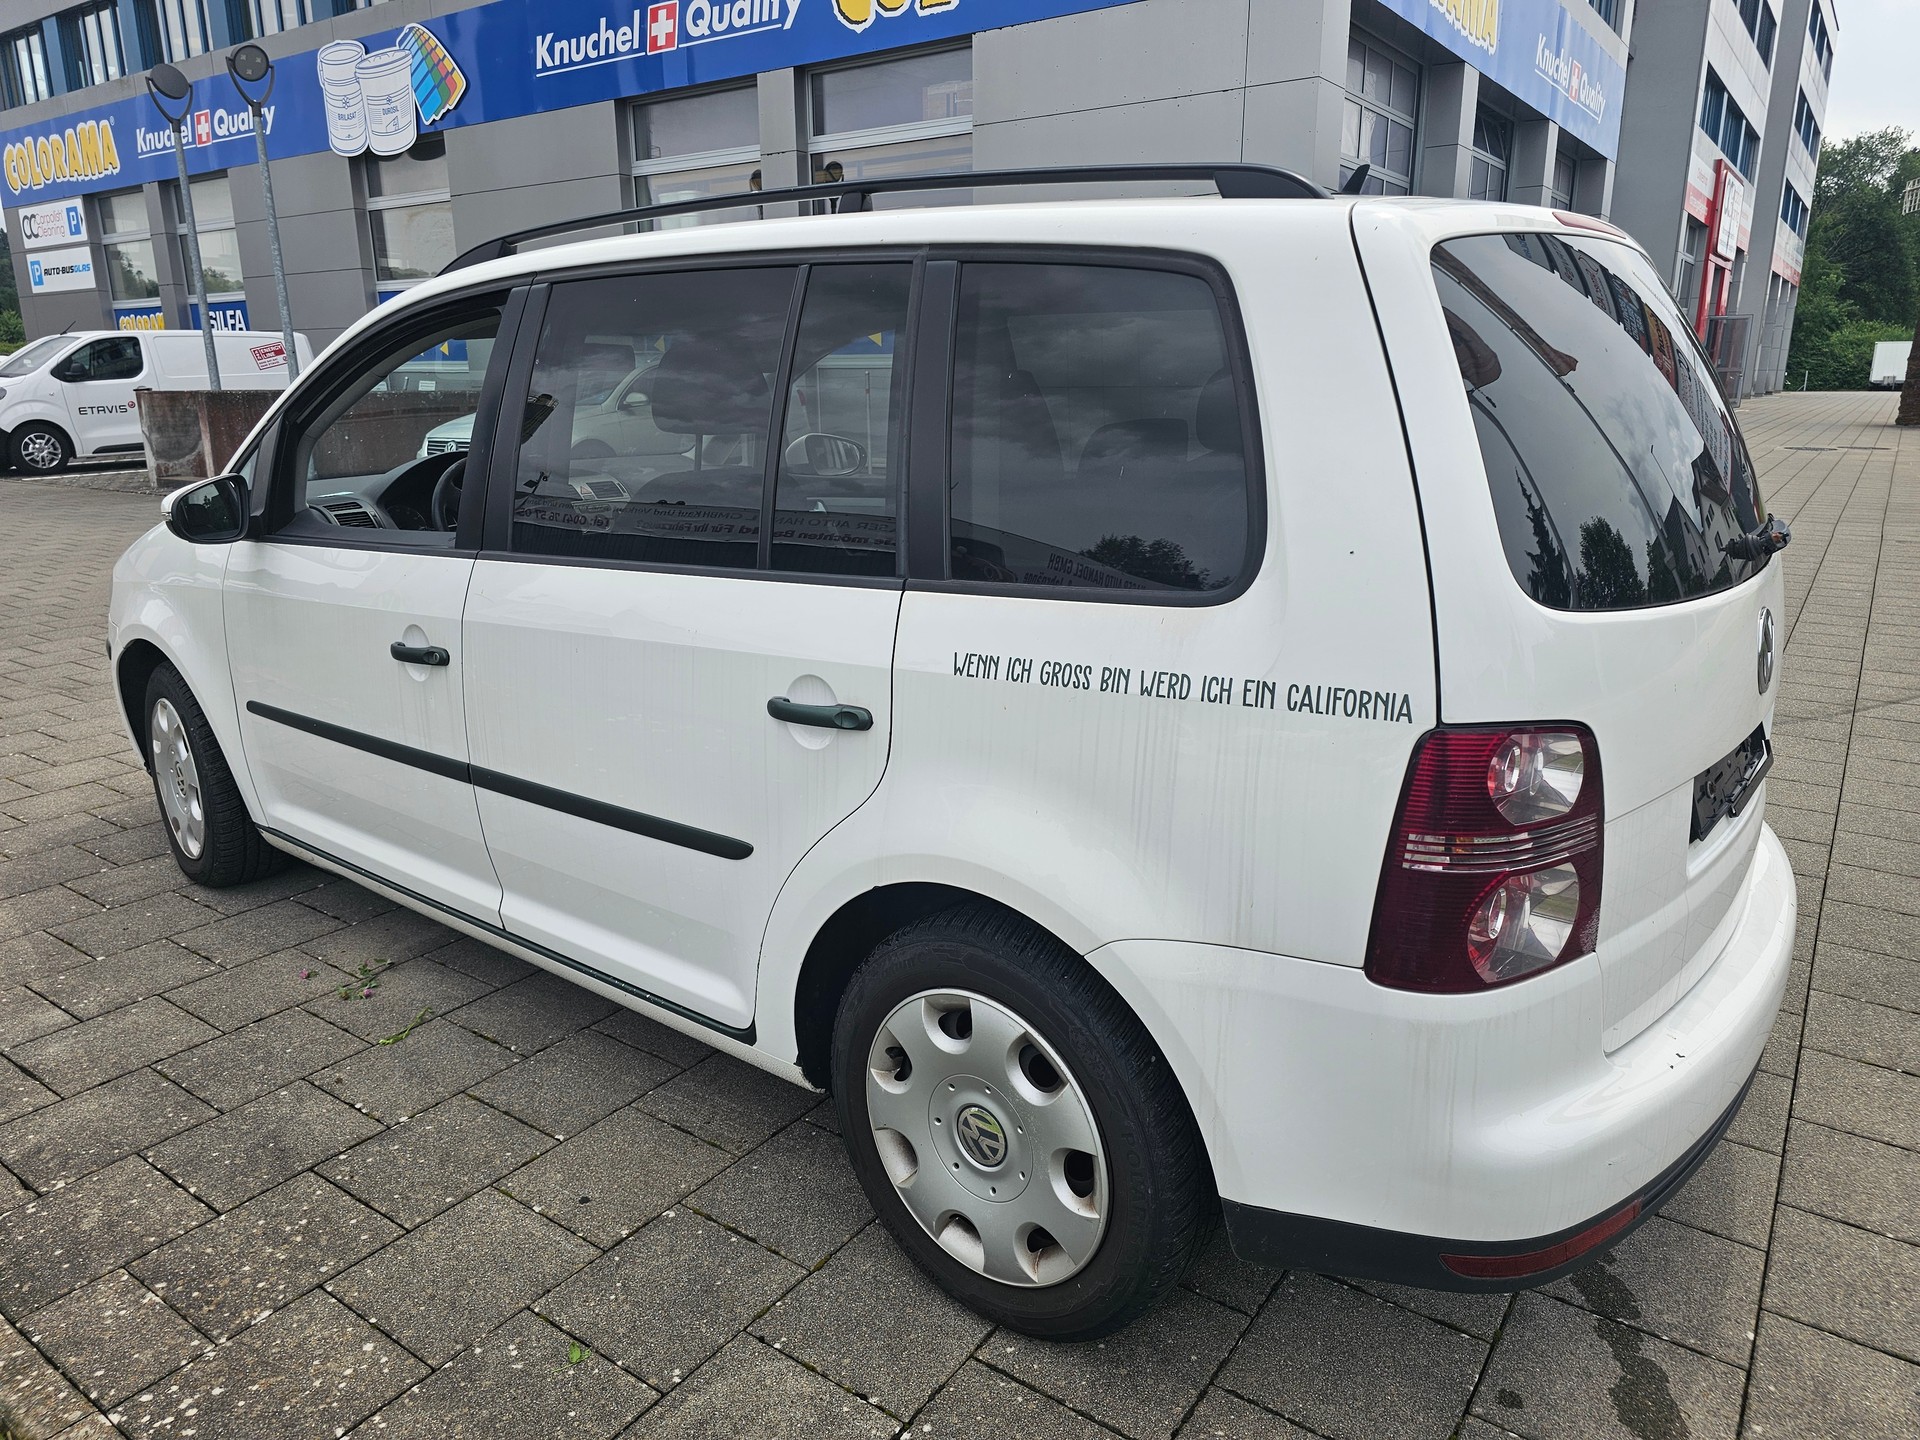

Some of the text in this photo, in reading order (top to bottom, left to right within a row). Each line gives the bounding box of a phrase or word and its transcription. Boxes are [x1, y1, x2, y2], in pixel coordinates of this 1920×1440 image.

[536, 9, 640, 70] Knuchel
[1535, 33, 1606, 124] Knuchel Quality
[213, 106, 275, 136] Qualy
[4, 120, 120, 195] COLORAMA
[78, 404, 128, 415] ETAVIS
[953, 652, 1413, 724] WENN ICH GROSS BIN WERD ICH EIN CALIFORNIA
